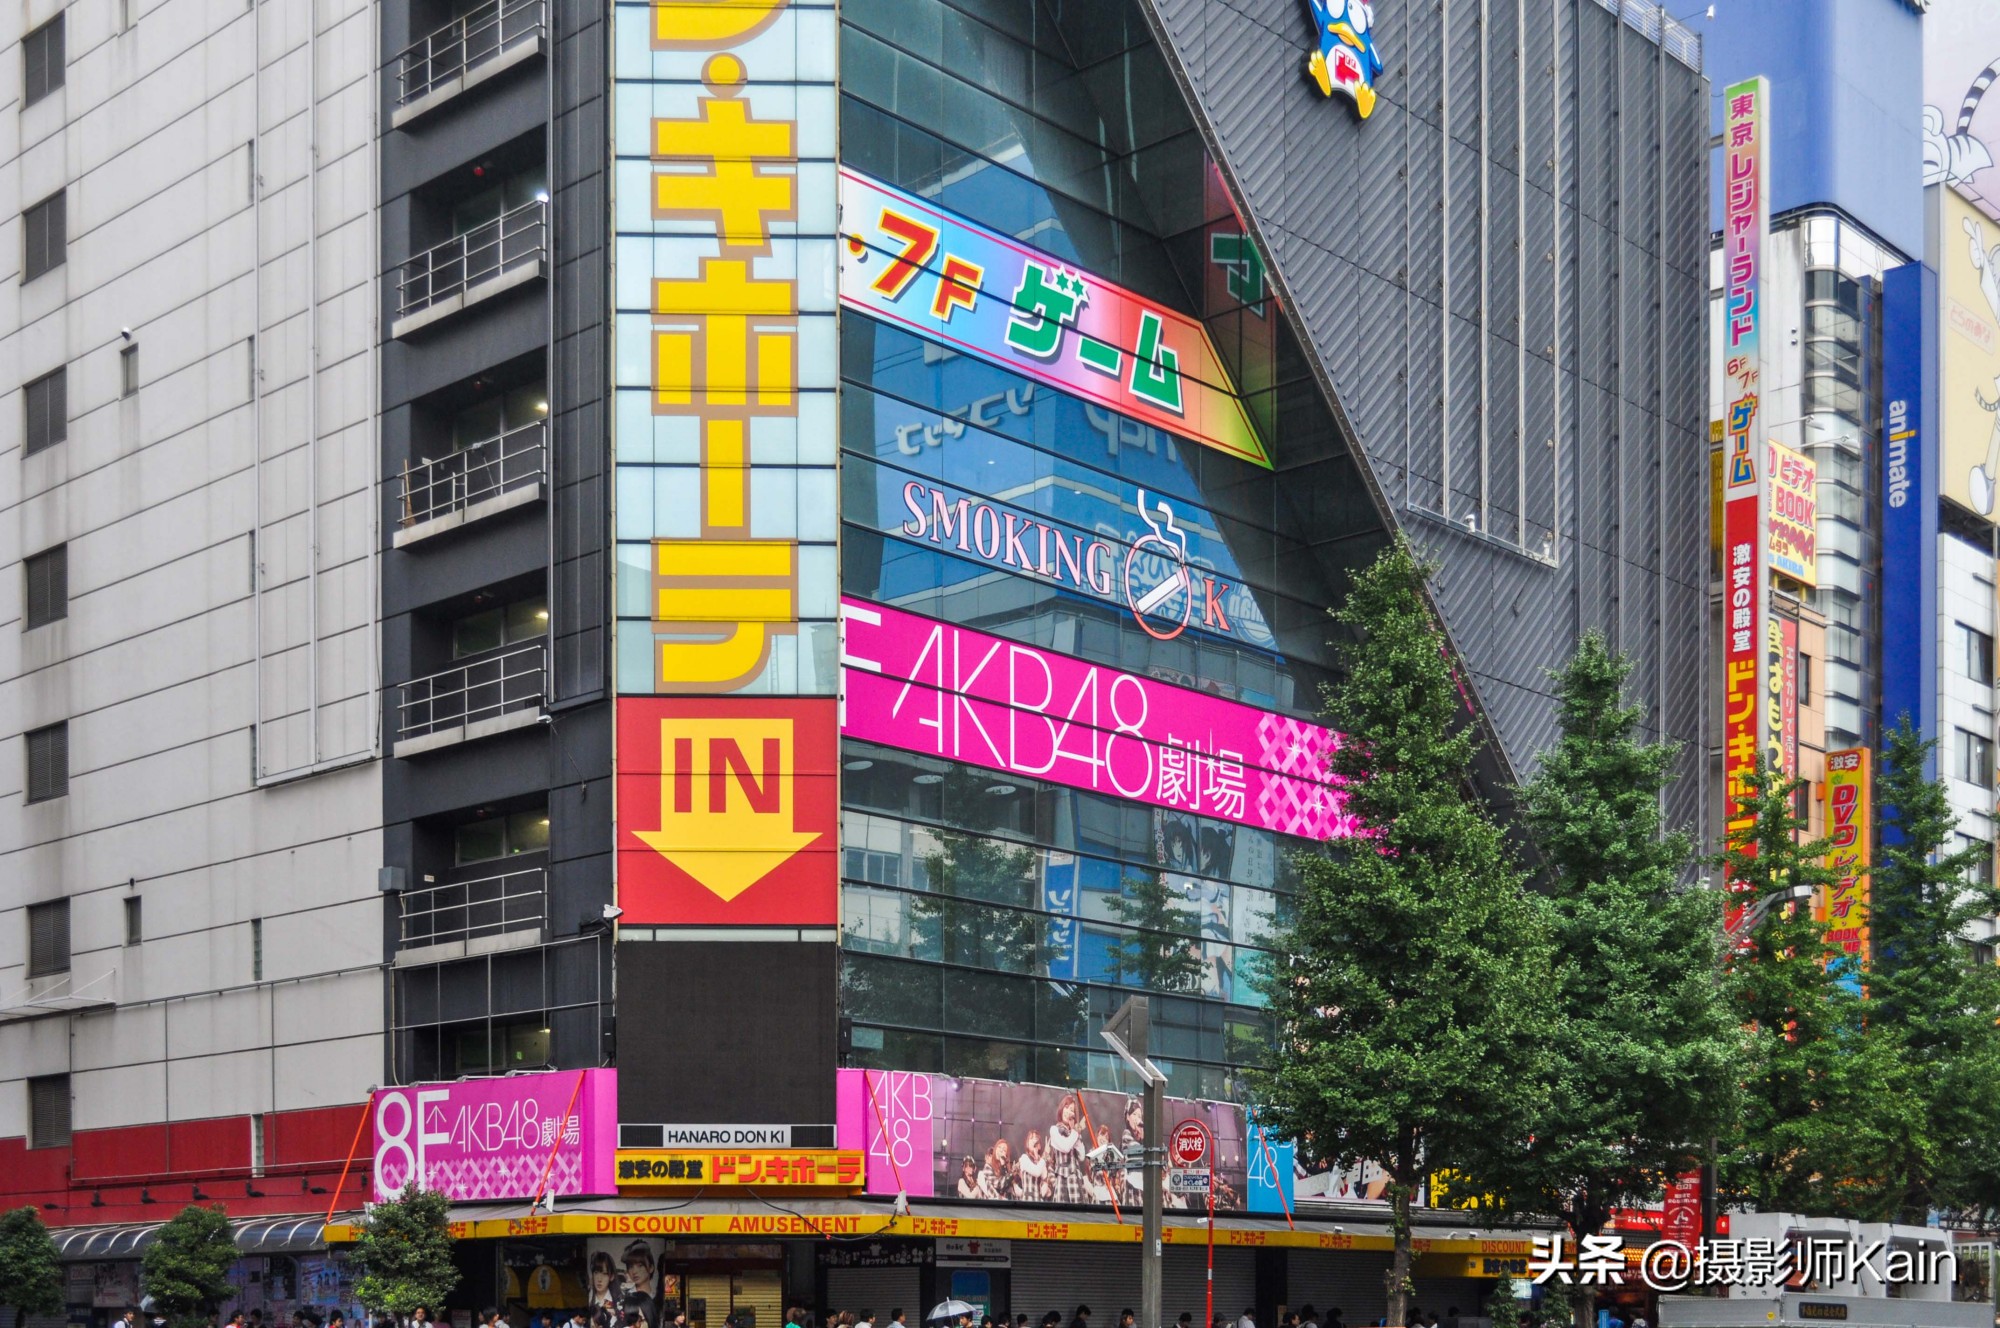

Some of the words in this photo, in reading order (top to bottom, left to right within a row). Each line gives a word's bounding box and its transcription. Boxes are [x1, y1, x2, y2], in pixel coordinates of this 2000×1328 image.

[1004, 259, 1184, 415] ゲーム
[1727, 357, 1748, 376] 6F
[1738, 371, 1758, 389] 7F
[1730, 401, 1755, 486] ゲーム
[1889, 400, 1916, 508] animate
[1780, 452, 1815, 496] ビデオ
[1776, 486, 1815, 531] BOOK
[903, 480, 1111, 595] SMOKING
[1732, 543, 1750, 652] 激安の殿堂
[674, 737, 781, 814] IN
[1830, 753, 1858, 770] 激安
[869, 1071, 933, 1121] AKB
[374, 1089, 449, 1201] 8F
[668, 1130, 731, 1143] HANARO
[734, 1130, 767, 1143] DON
[770, 1130, 785, 1143] KI
[870, 1118, 912, 1167] 48
[1179, 1137, 1203, 1151] 消火栓
[1248, 1147, 1279, 1188] 48
[596, 1216, 704, 1233] DISCOUNT
[728, 1216, 861, 1233] AMUSEMENT
[1481, 1241, 1526, 1253] DISCOUNT
